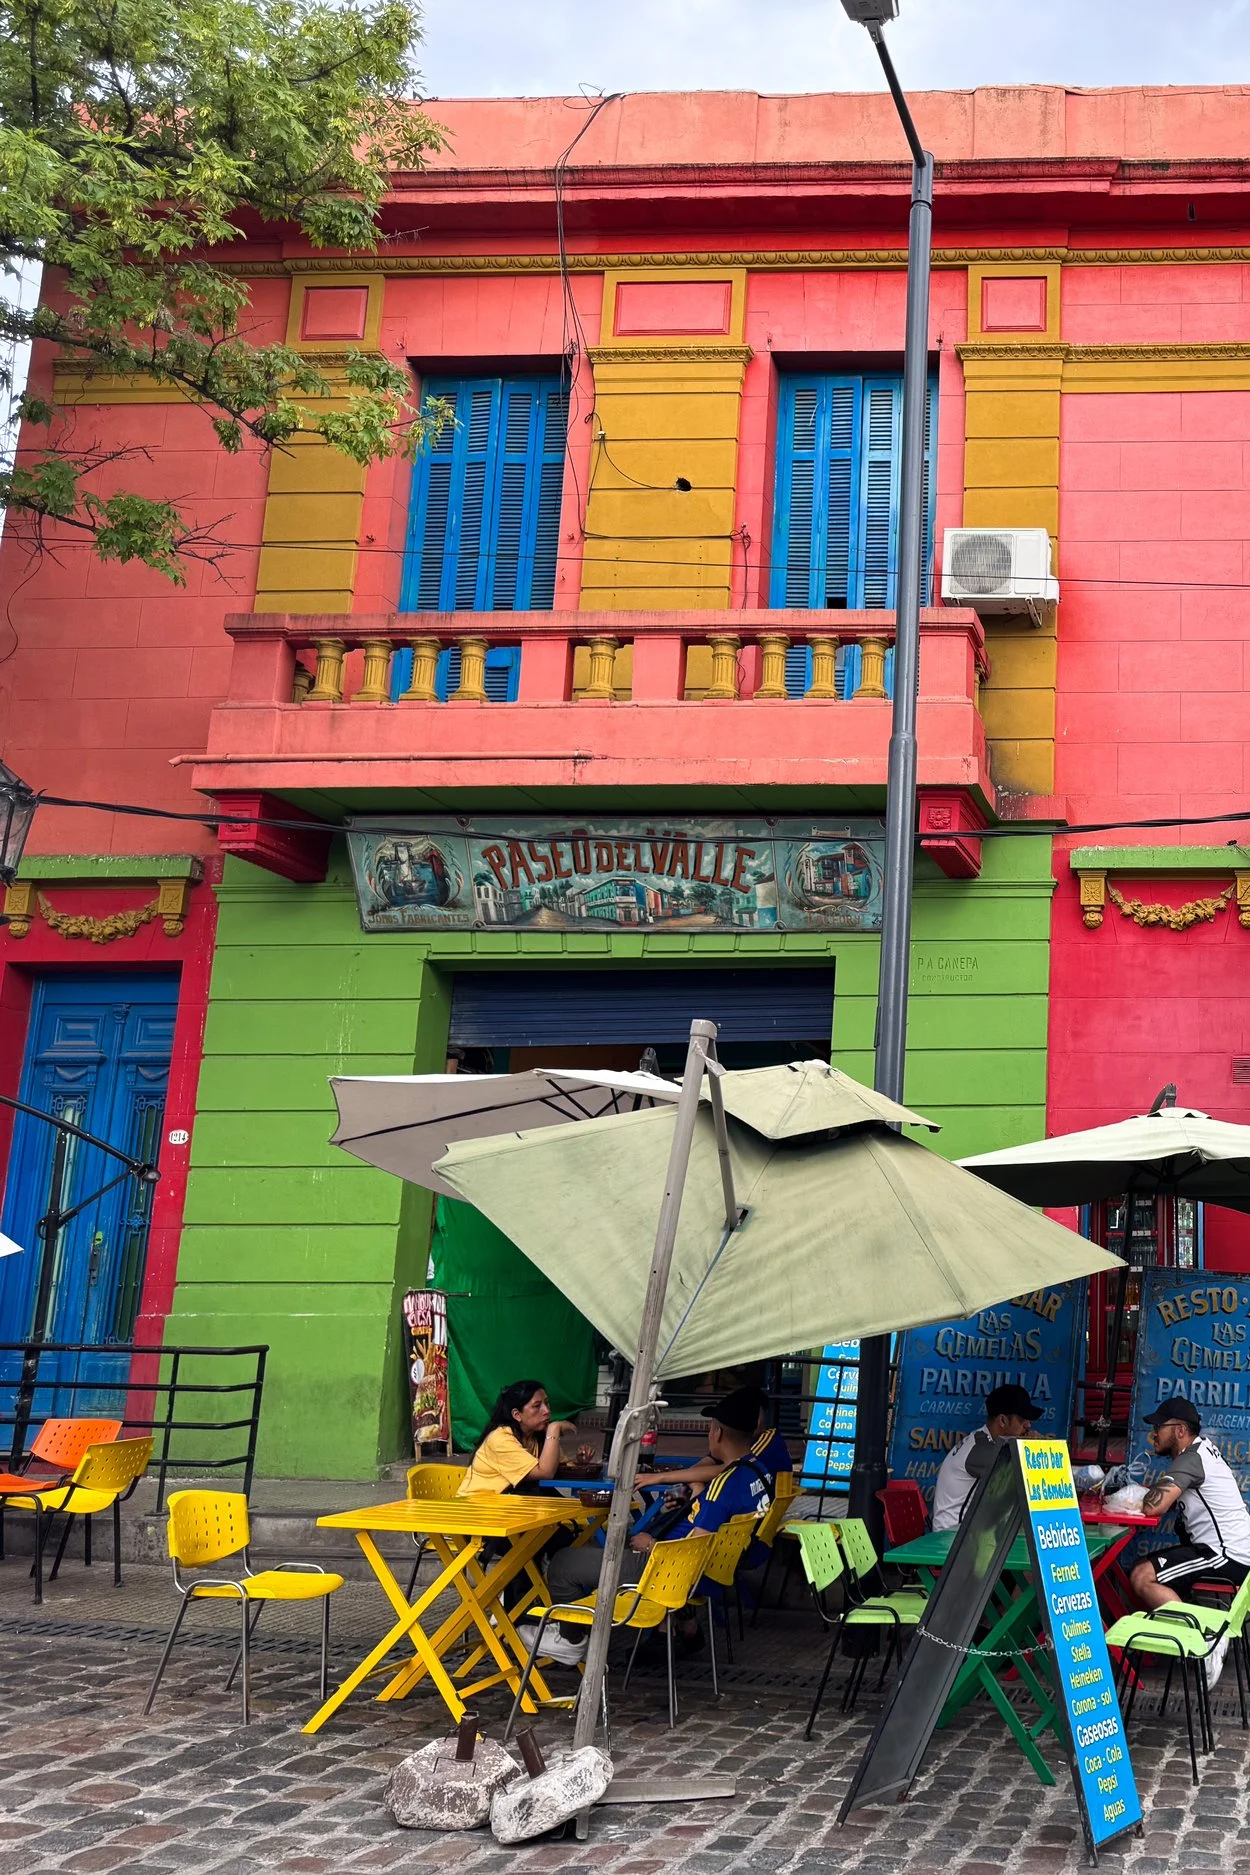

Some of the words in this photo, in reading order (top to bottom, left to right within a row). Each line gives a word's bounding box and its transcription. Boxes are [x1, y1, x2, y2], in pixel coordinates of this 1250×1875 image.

[481, 834, 591, 892] PASEO
[645, 830, 757, 894] VALLE
[937, 957, 979, 970] CANEPA
[1157, 1287, 1239, 1326] RESTO
[977, 1310, 1012, 1335] LAS
[1211, 1322, 1247, 1345] LAS
[935, 1327, 1042, 1361] GEMELAS
[919, 1400, 972, 1414] CARNES
[1025, 1446, 1048, 1470] Resto
[1050, 1447, 1063, 1468] bar
[1027, 1481, 1041, 1501] Las
[1042, 1478, 1074, 1500] Gemelas
[1037, 1522, 1080, 1550] Bebidas
[1051, 1562, 1080, 1583] Fernet
[1051, 1591, 1092, 1615] Cervezas
[1061, 1619, 1092, 1642] Quilmes
[1071, 1643, 1092, 1662] Stella
[1069, 1667, 1104, 1689] Heineken
[1071, 1695, 1096, 1716] Corona
[1076, 1716, 1119, 1748] Gaseosas
[1085, 1754, 1103, 1774] Coca
[1105, 1744, 1122, 1764] Cola
[1097, 1769, 1118, 1794] Pepsi
[1103, 1798, 1126, 1823] Aguas
